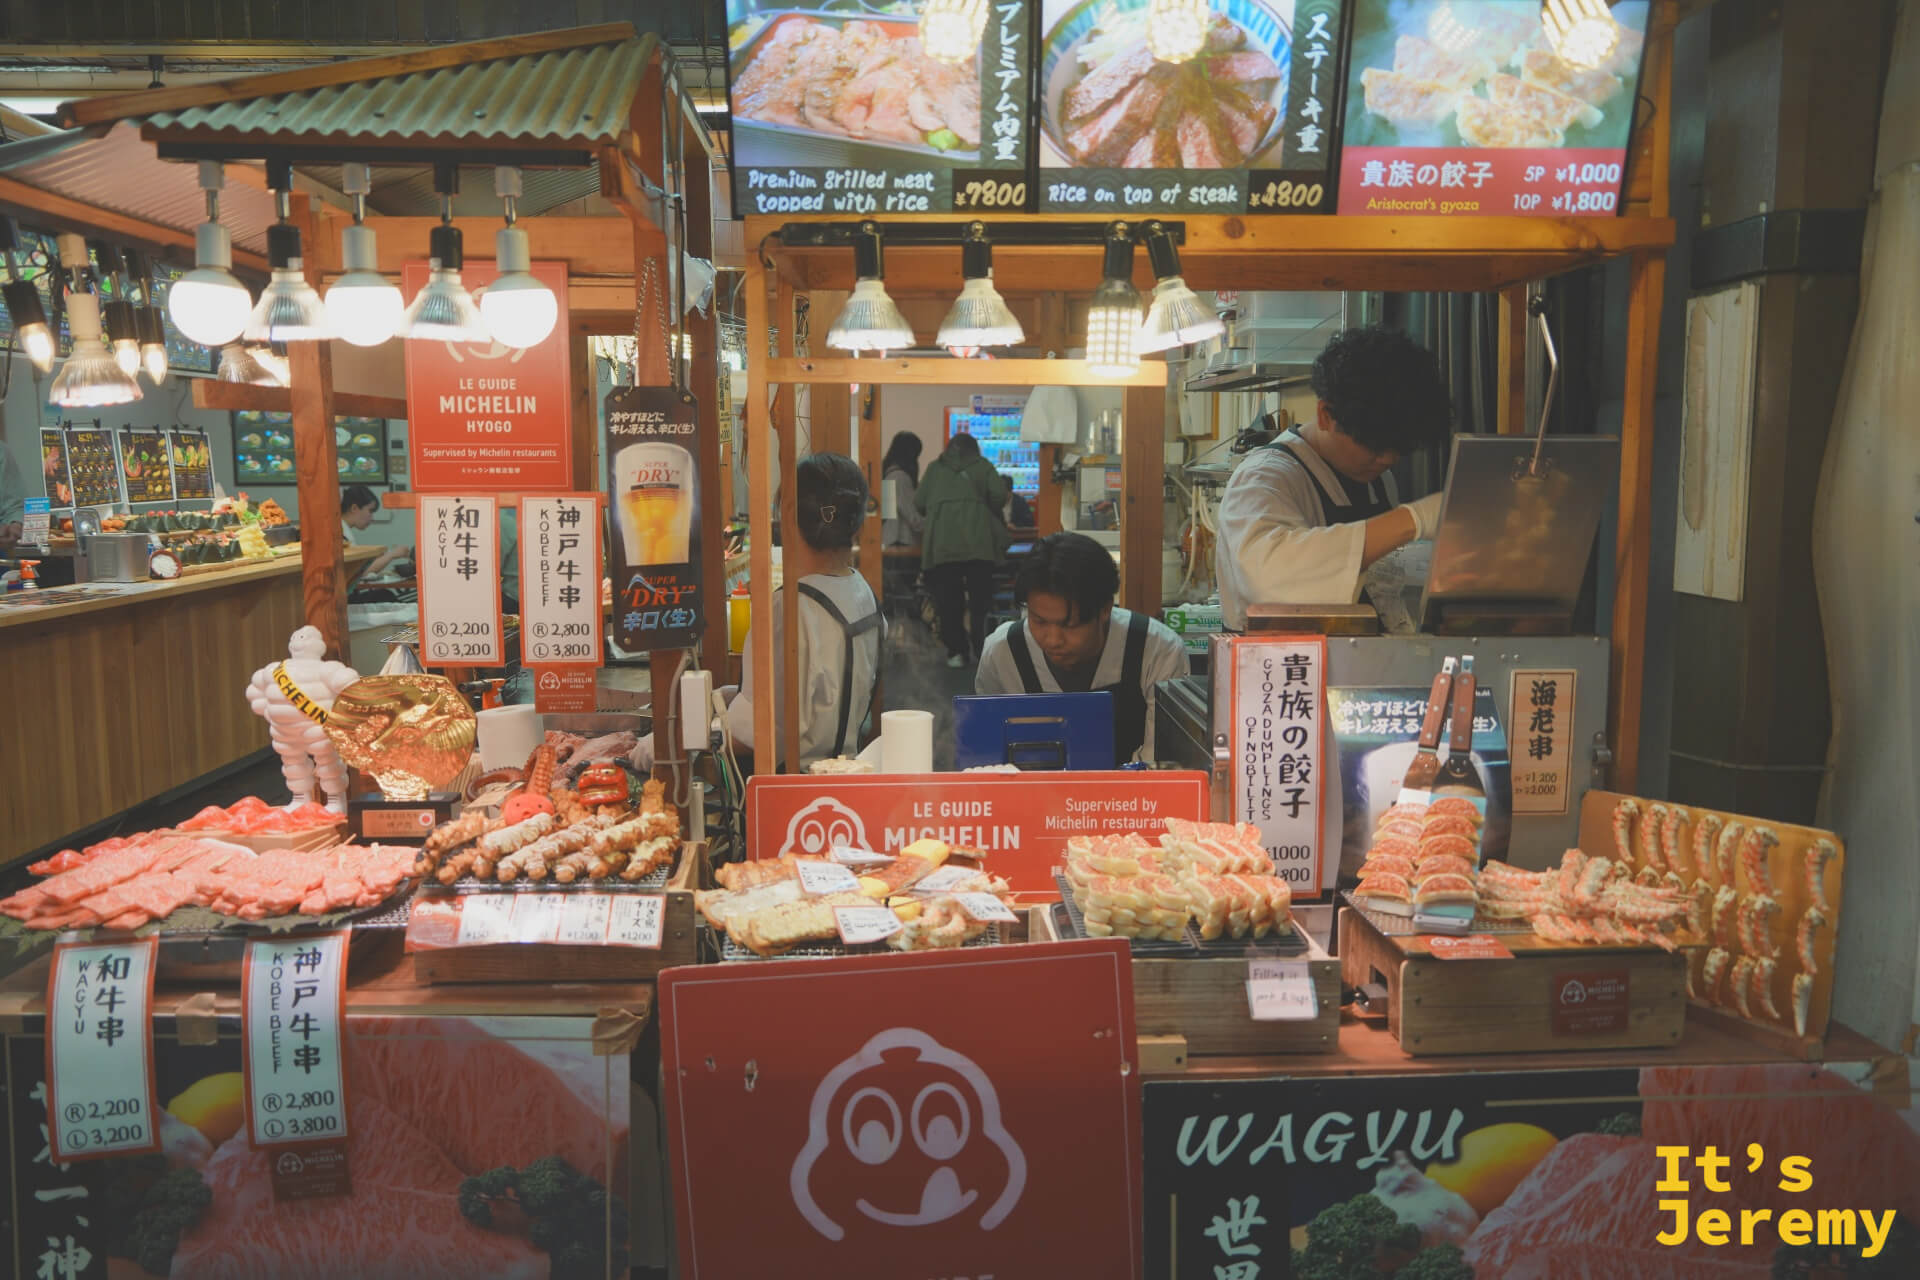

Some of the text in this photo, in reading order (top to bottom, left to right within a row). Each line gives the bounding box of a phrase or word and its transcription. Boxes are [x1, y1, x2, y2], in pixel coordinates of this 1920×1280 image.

[1295, 12, 1332, 153] ステーキ重
[748, 169, 936, 191] Premium grilled meat
[1360, 160, 1494, 189] 貴族の餃子
[1523, 163, 1621, 186] 5P ¥1,000
[755, 192, 929, 214] topped with rice
[1048, 183, 1239, 206] Rice on top of steak
[1366, 196, 1481, 214] Aristocrat's gyoza
[1513, 192, 1616, 214] 10P ¥1,800
[459, 378, 517, 391] LE GUIDE
[439, 395, 537, 414] MICHELIN
[466, 420, 512, 433] HYOGO
[609, 411, 665, 423] 冷やすほどに
[423, 447, 557, 460] Supervised by Michelin restaurants
[437, 506, 448, 569] WAGYU
[453, 504, 480, 582] 和牛串
[556, 505, 582, 610] 神戸牛串
[450, 622, 490, 638] 2,200
[551, 623, 590, 639] 2,800
[451, 643, 491, 658] 3,200
[552, 643, 591, 658] 3,800
[1528, 679, 1557, 761] 海老串
[1261, 658, 1274, 821] GYOZA DUMPLINGS
[1277, 652, 1314, 820] 貴族の餃子
[1245, 716, 1257, 826] OF NOBILIT
[913, 800, 993, 818] LE GUIDE
[1065, 797, 1158, 816] Supervised by
[1045, 814, 1167, 831] Michelin restauran
[74, 959, 92, 1035] WAGYU
[94, 953, 131, 1048] 和牛串
[288, 946, 322, 1075] 神戸牛串
[88, 1098, 140, 1120] 2,200
[285, 1090, 335, 1111] 2,800
[92, 1125, 143, 1147] 3,200
[288, 1115, 337, 1136] 3,800
[1176, 1107, 1465, 1171] WAGYU
